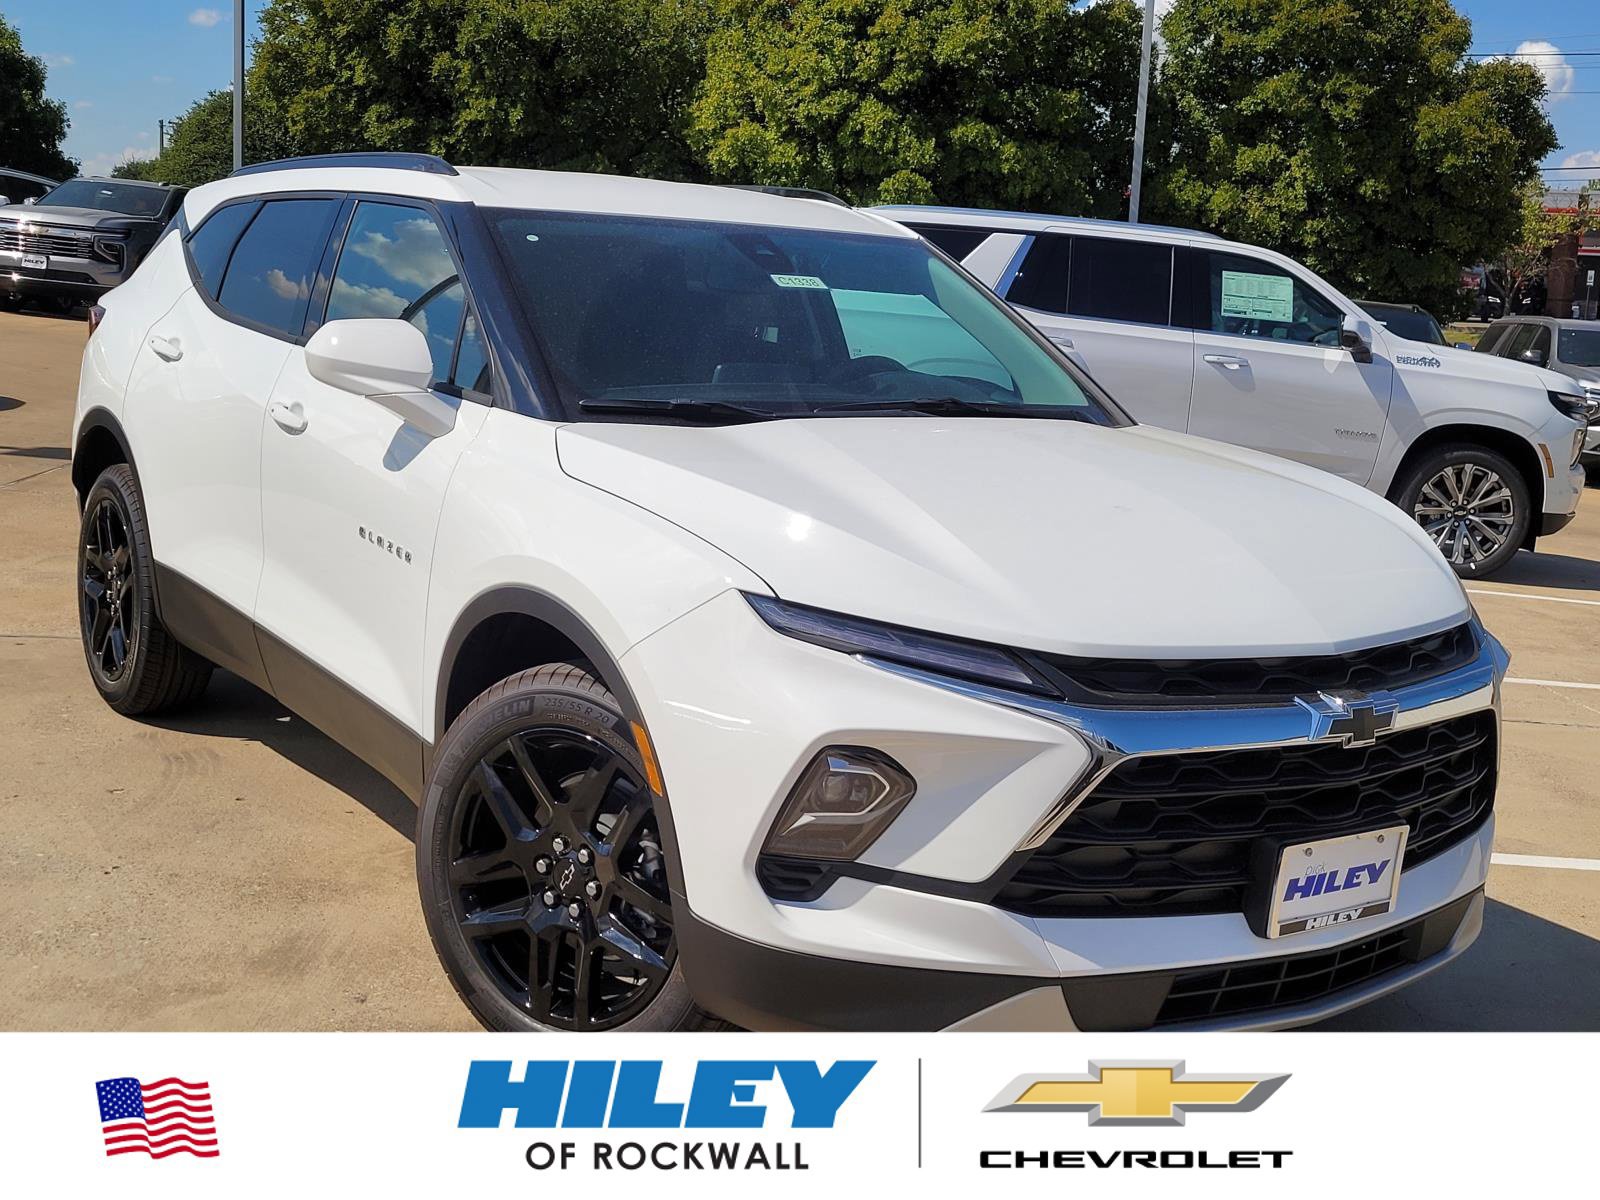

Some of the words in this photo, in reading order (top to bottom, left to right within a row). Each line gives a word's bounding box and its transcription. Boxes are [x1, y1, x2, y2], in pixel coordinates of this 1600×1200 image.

[778, 276, 819, 287] C1338
[359, 526, 412, 565] BLAZER
[544, 697, 582, 712] 235/55
[595, 712, 611, 725] 20
[1283, 859, 1391, 902] HILEY
[1305, 907, 1364, 931] HILEY
